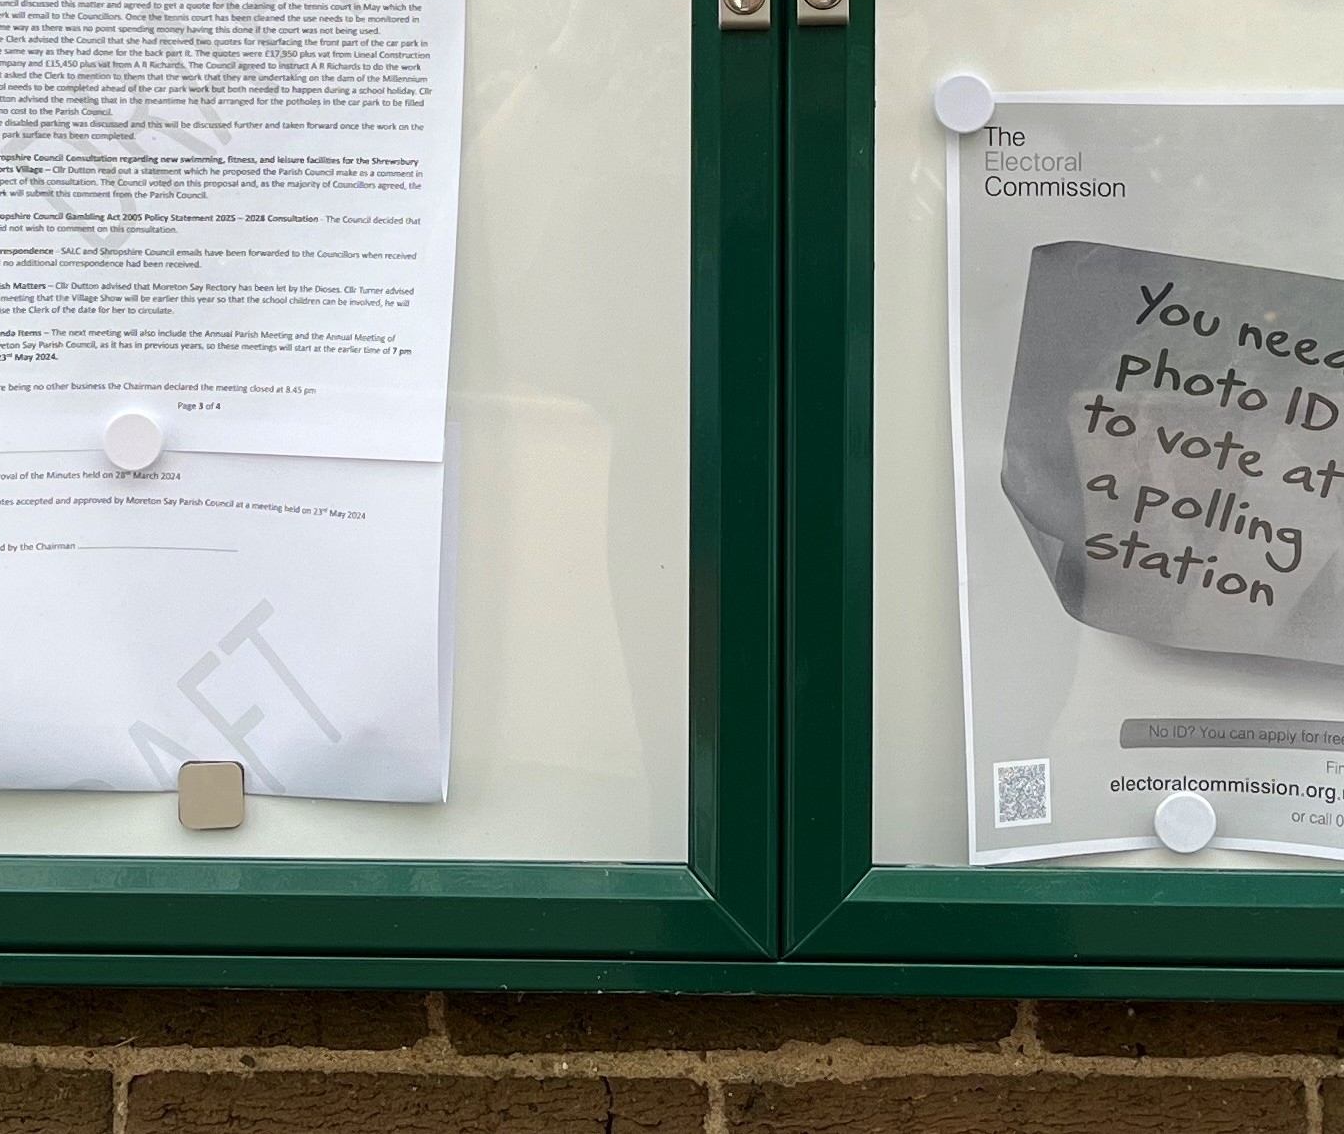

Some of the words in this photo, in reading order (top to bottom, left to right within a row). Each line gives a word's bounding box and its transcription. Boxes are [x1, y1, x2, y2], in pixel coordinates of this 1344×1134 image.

[984, 126, 1025, 147] The
[985, 151, 1082, 172] Electoral
[985, 176, 1125, 197] Commission
[1136, 282, 1220, 337] You
[1115, 348, 1268, 411] photo
[1285, 386, 1339, 431] ID
[1084, 394, 1136, 437] to
[1157, 426, 1263, 477] vote
[1086, 474, 1119, 500] a
[1134, 485, 1304, 572] polling
[7, 543, 18, 552] by
[19, 542, 34, 551] the
[35, 542, 75, 551] Chairman
[1084, 531, 1275, 607] station
[1149, 724, 1169, 738] No
[1172, 725, 1196, 738] ID?
[1199, 725, 1226, 739] You
[1229, 729, 1255, 740] can
[1258, 729, 1297, 744] apply
[1301, 729, 1319, 743] for
[1291, 812, 1306, 823] or
[1309, 812, 1332, 825] call
